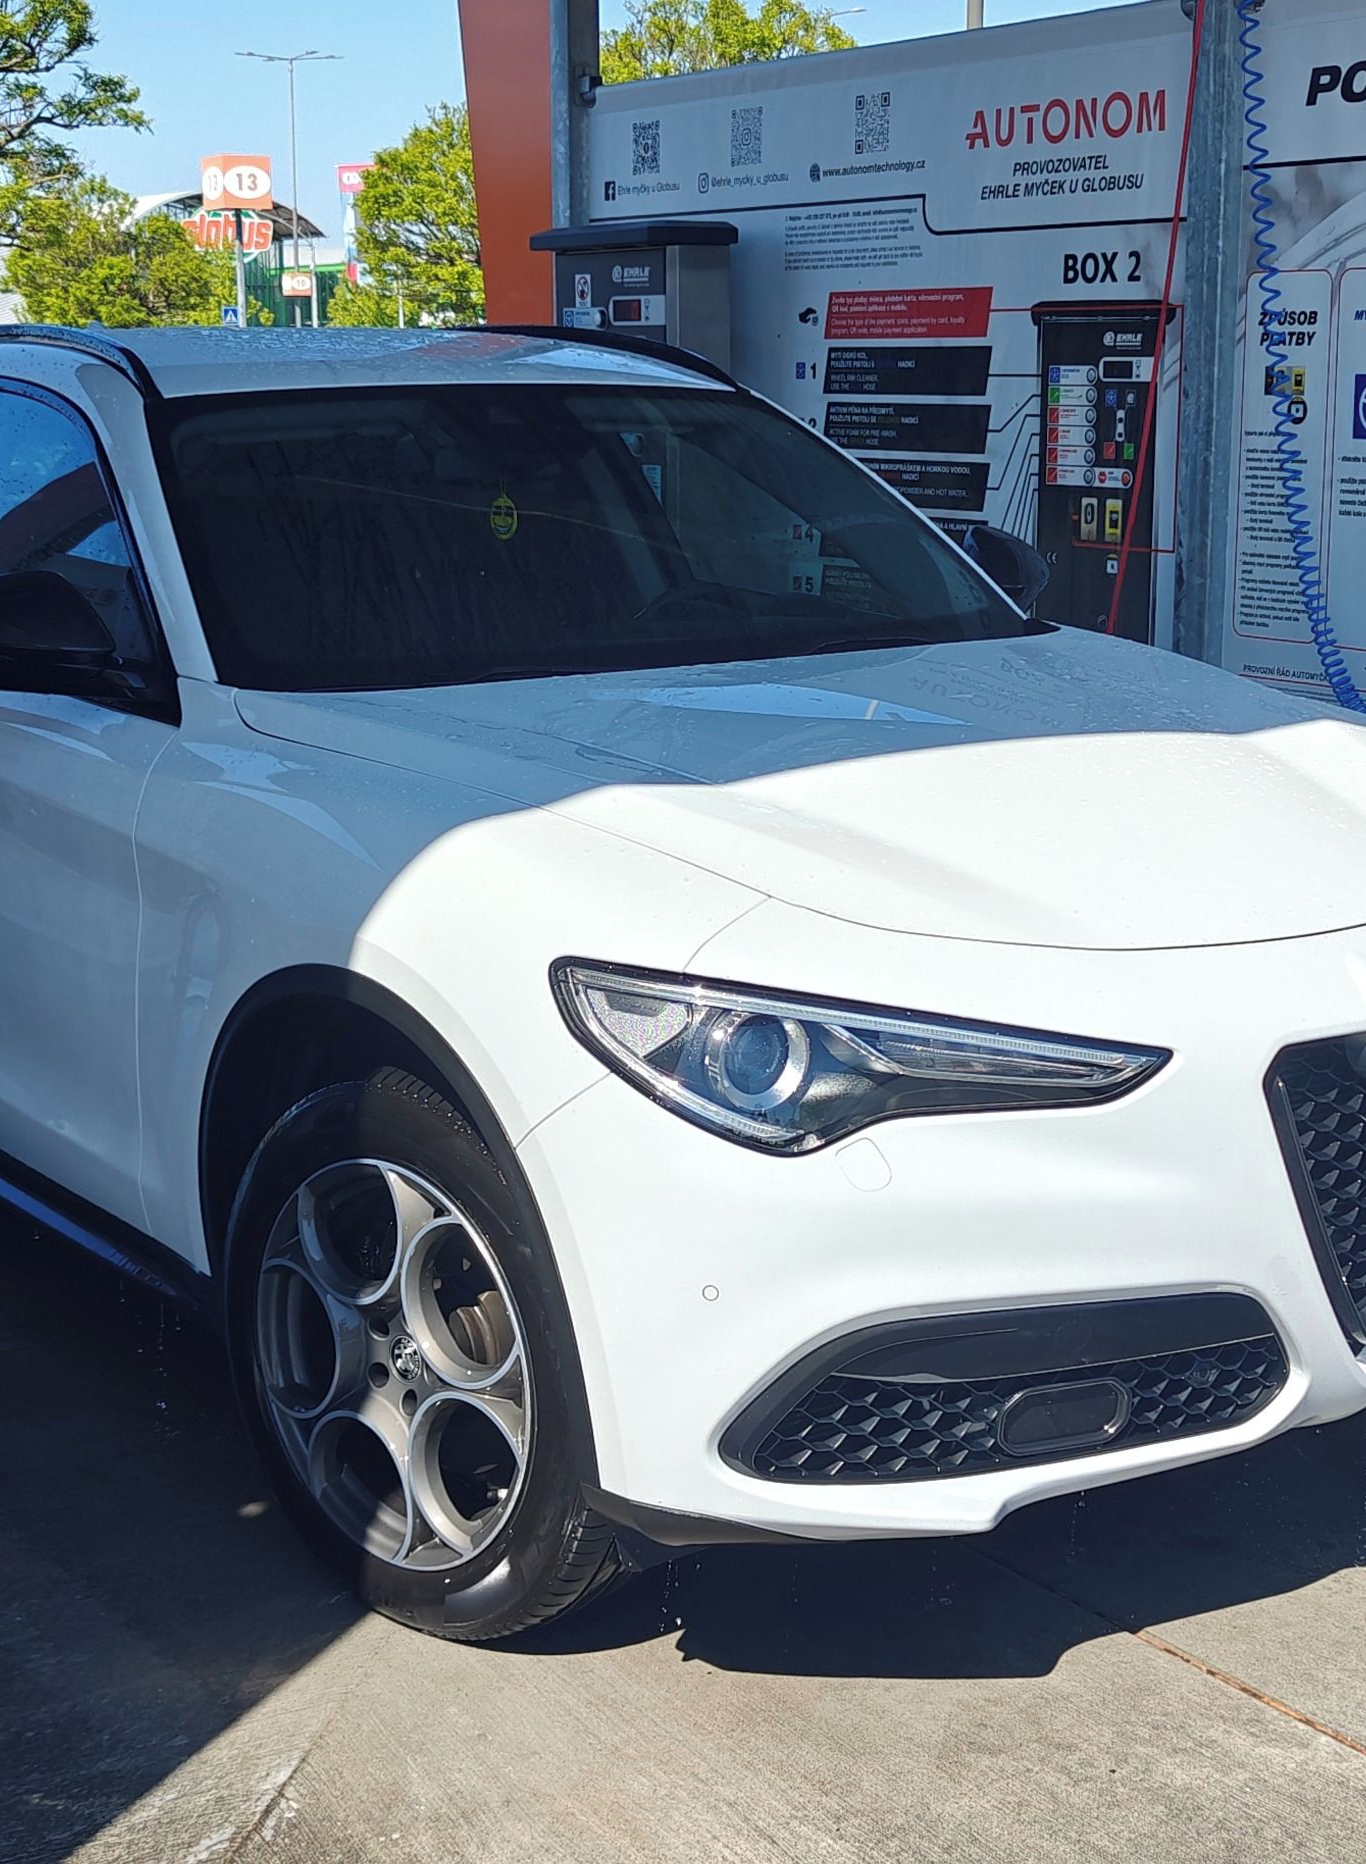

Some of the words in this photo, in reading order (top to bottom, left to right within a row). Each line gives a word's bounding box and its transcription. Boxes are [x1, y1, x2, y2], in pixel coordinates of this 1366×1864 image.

[965, 89, 1166, 149] AUTONOM
[822, 159, 926, 178] www.autonomtechnology.cz
[1012, 154, 1109, 177] PROVOZOVATEL
[236, 173, 258, 191] 13
[618, 185, 633, 195] Ehrle
[657, 181, 680, 192] Globusu
[980, 184, 1021, 200] EHRLE
[1023, 179, 1065, 197] MYČEK
[1069, 179, 1079, 193] U
[1081, 174, 1144, 192] GLOBUSU
[1062, 251, 1118, 284] BOX
[1127, 250, 1141, 282] 2
[810, 362, 817, 379] 1
[805, 525, 814, 542] 4
[805, 577, 814, 593] 5
[1243, 664, 1275, 675] PROVOZNÍ
[1276, 666, 1290, 677] ŘÁD
